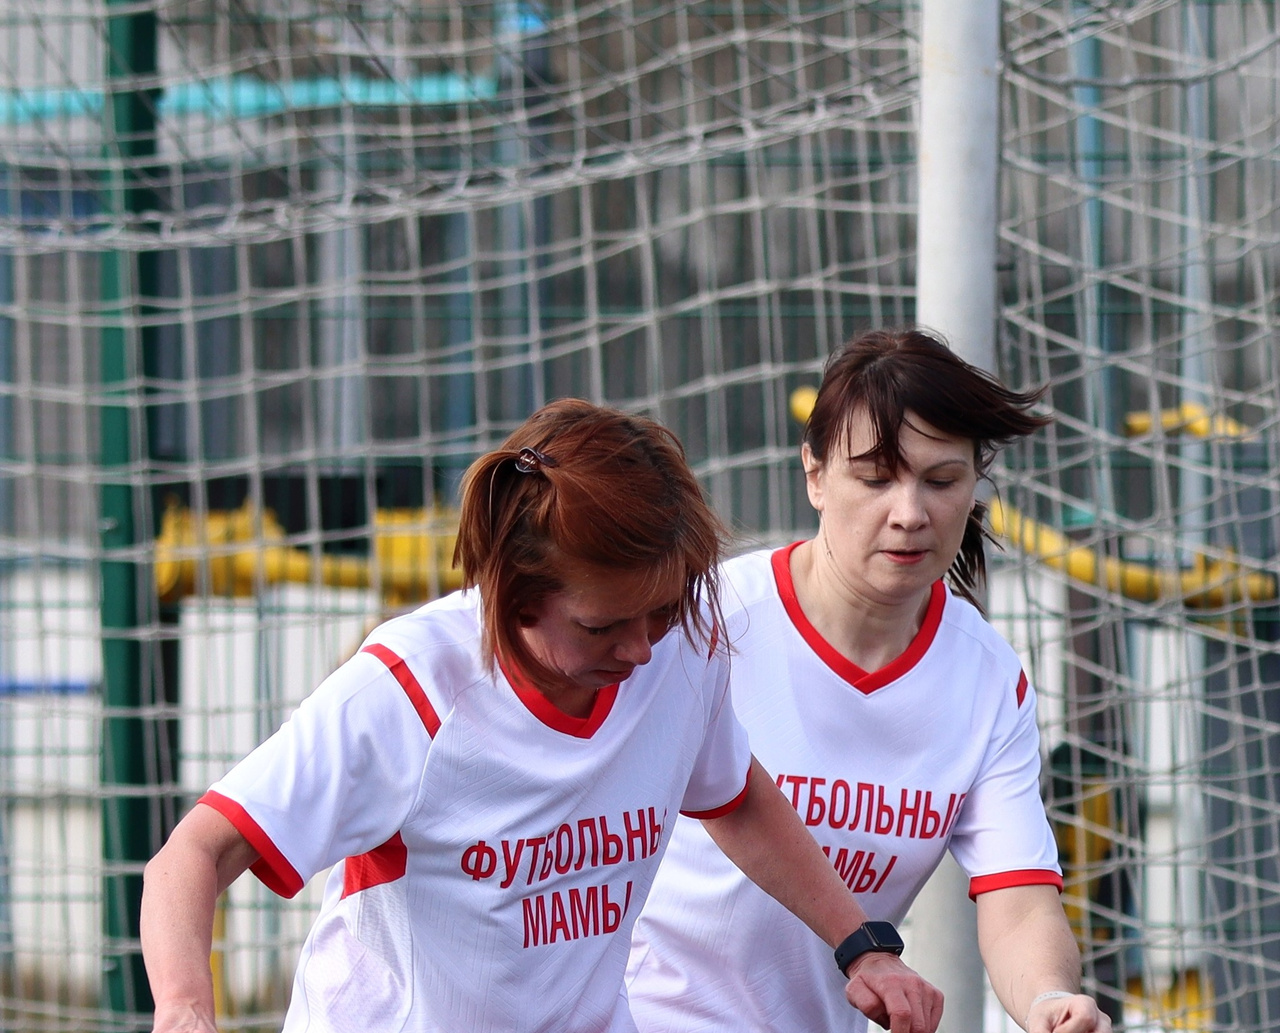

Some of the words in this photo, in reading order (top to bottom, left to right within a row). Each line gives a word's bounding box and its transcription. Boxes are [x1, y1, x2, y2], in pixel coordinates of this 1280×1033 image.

[775, 774, 967, 840] ТБОЛЬНЫ
[460, 806, 668, 889] ФУТБОЛЬНЫ
[822, 846, 898, 894] МЫ
[522, 880, 633, 949] МАМЫ
